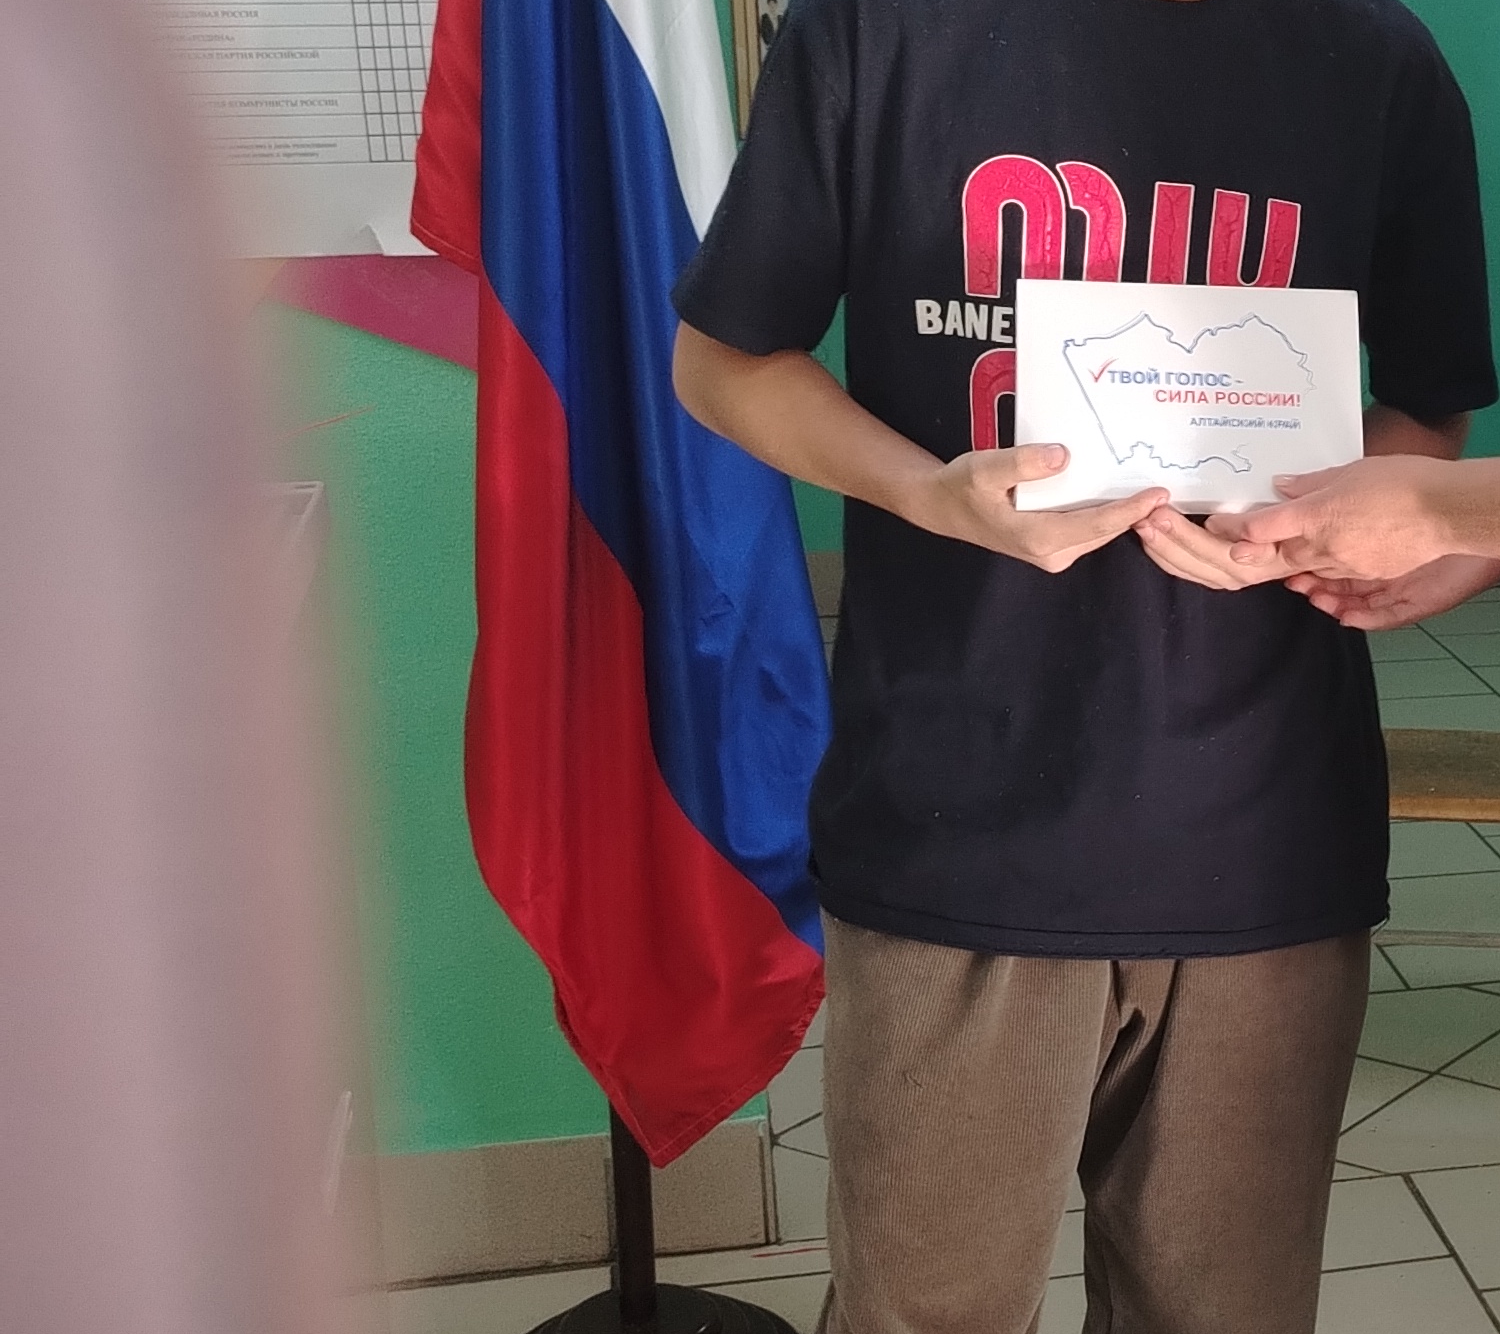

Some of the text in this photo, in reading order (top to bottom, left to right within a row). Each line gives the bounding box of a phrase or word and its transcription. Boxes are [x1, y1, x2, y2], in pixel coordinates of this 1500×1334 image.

[1108, 367, 1160, 385] ТВОЙ
[1165, 372, 1232, 387] ГОЛОС
[1155, 389, 1301, 407] СИЛА РОССИИ!
[1190, 417, 1301, 430] АЛТАЙСКИЙ КРАЙ
